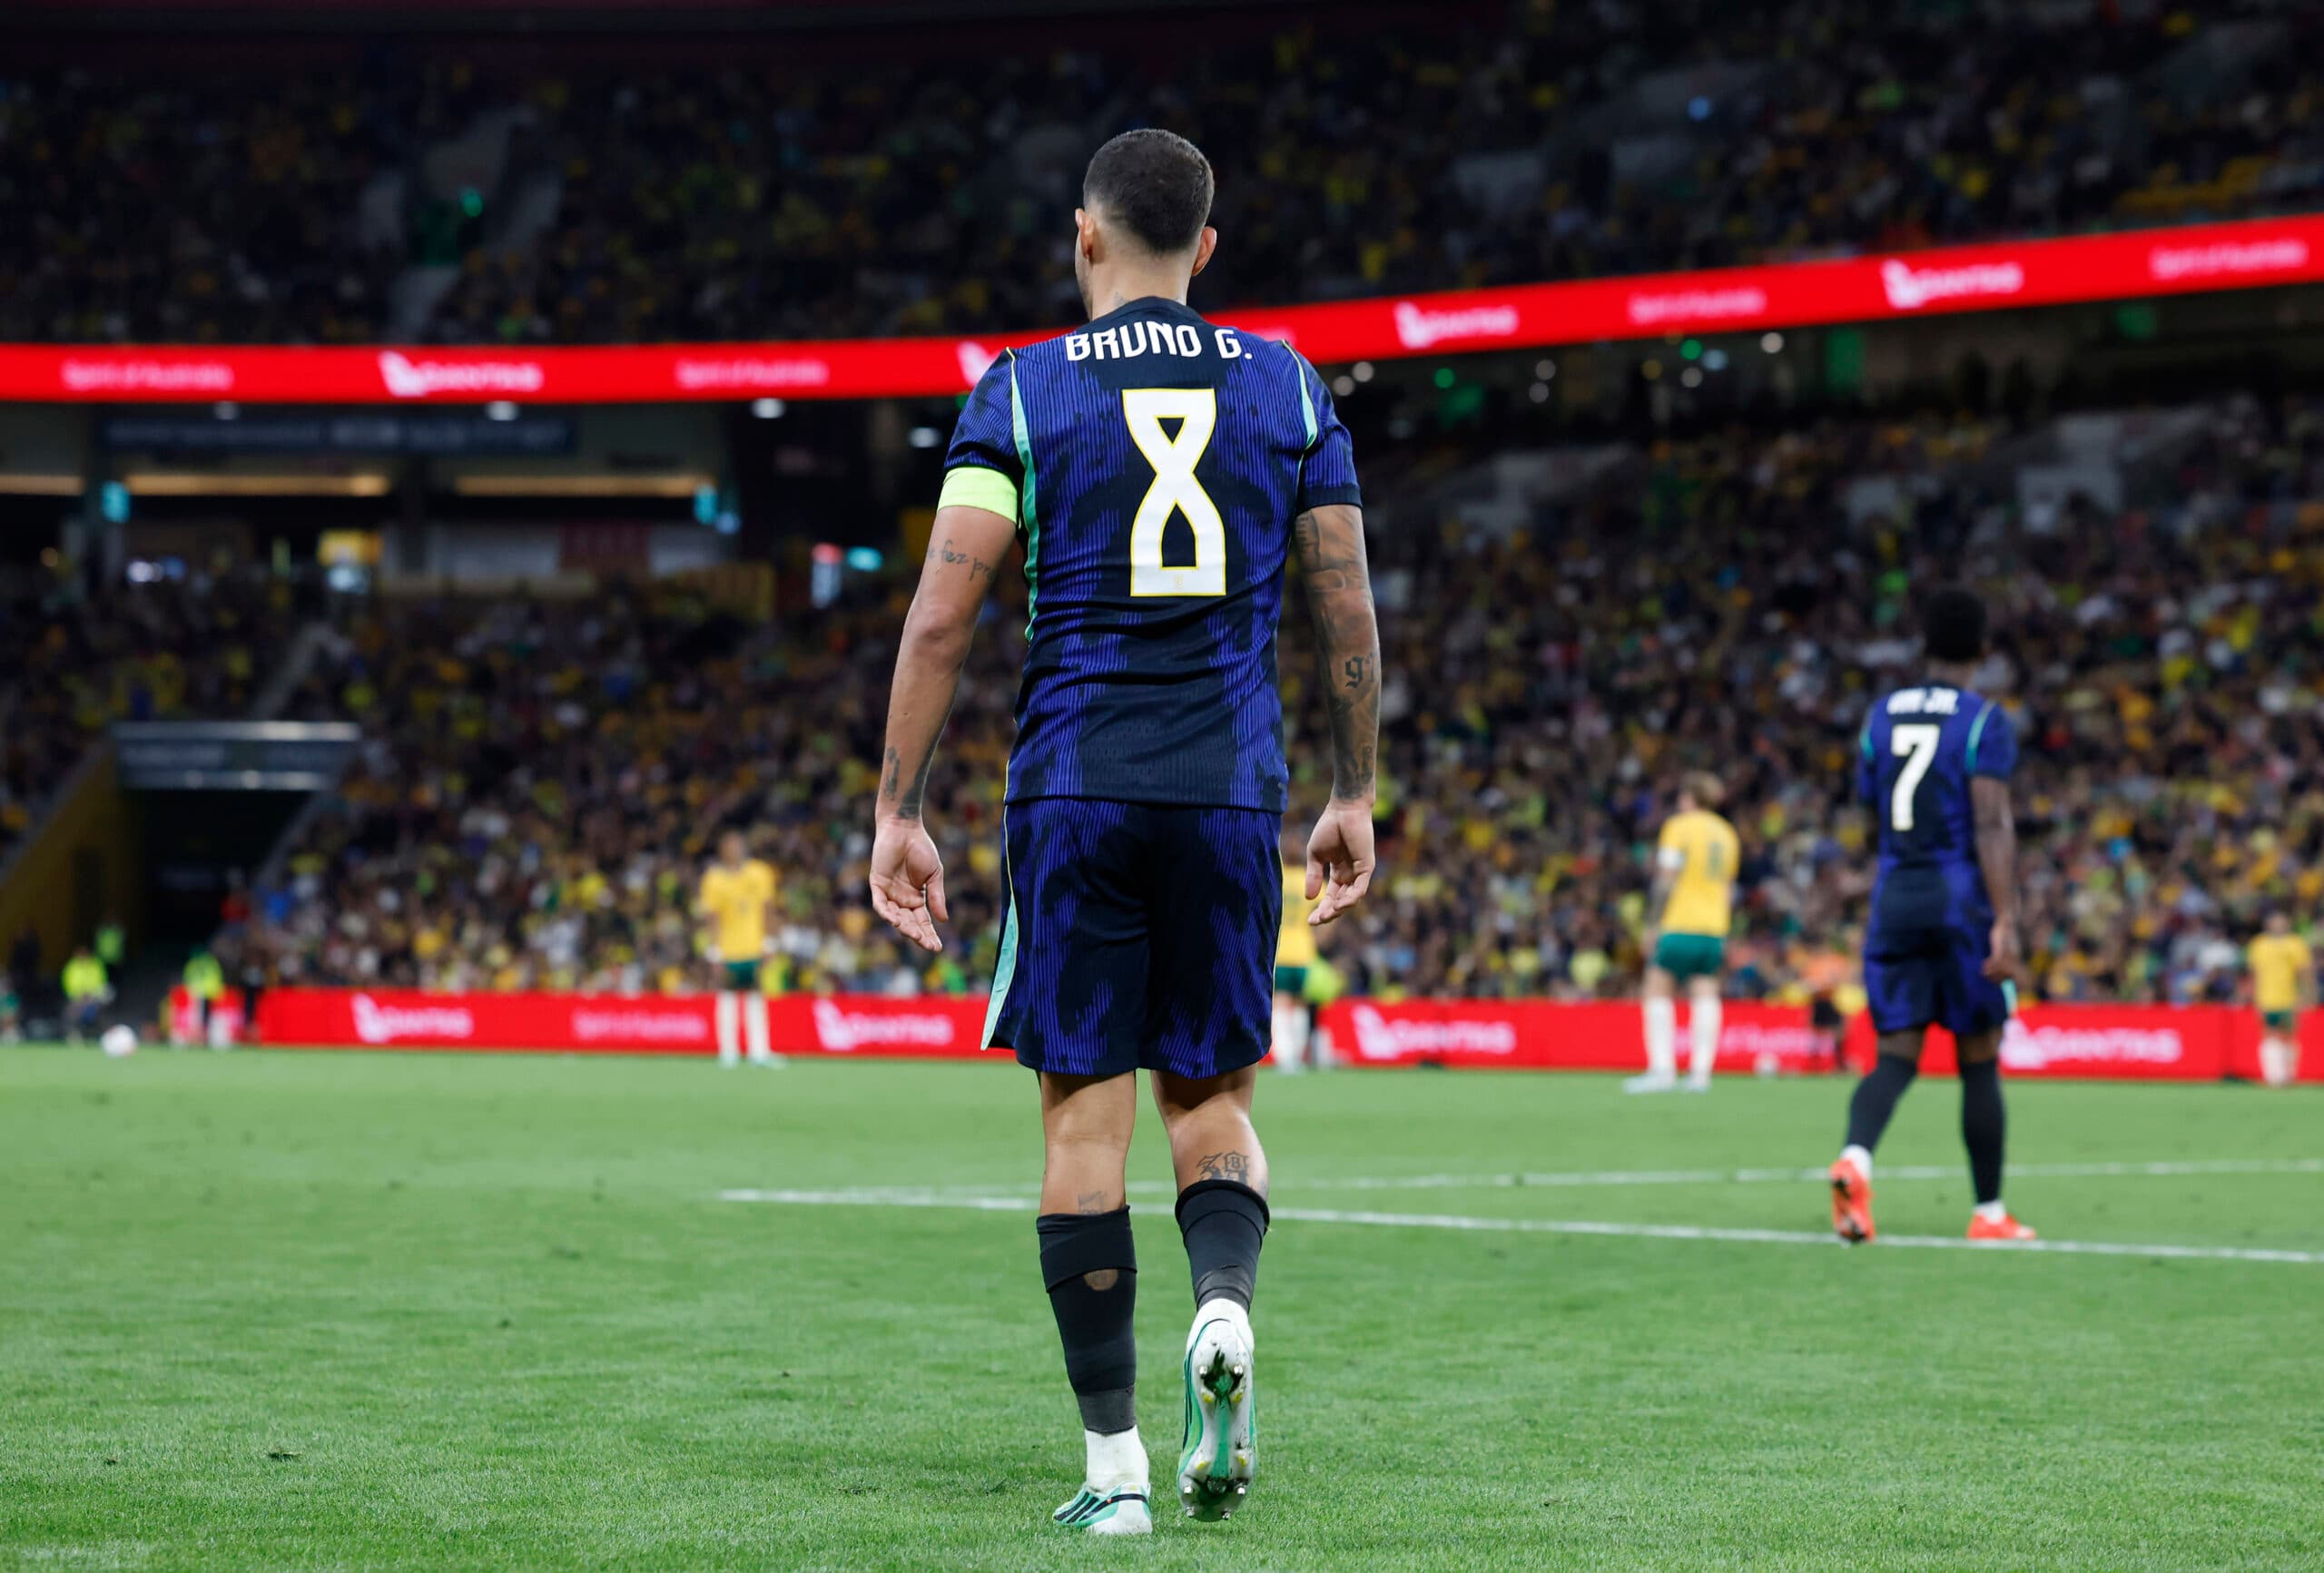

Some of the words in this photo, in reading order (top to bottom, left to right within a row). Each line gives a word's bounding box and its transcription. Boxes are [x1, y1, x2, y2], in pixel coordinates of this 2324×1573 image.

[1065, 321, 1202, 361] BRUNO
[1215, 329, 1253, 359] G.
[1122, 388, 1226, 597] 8
[1891, 723, 1941, 831] 7
